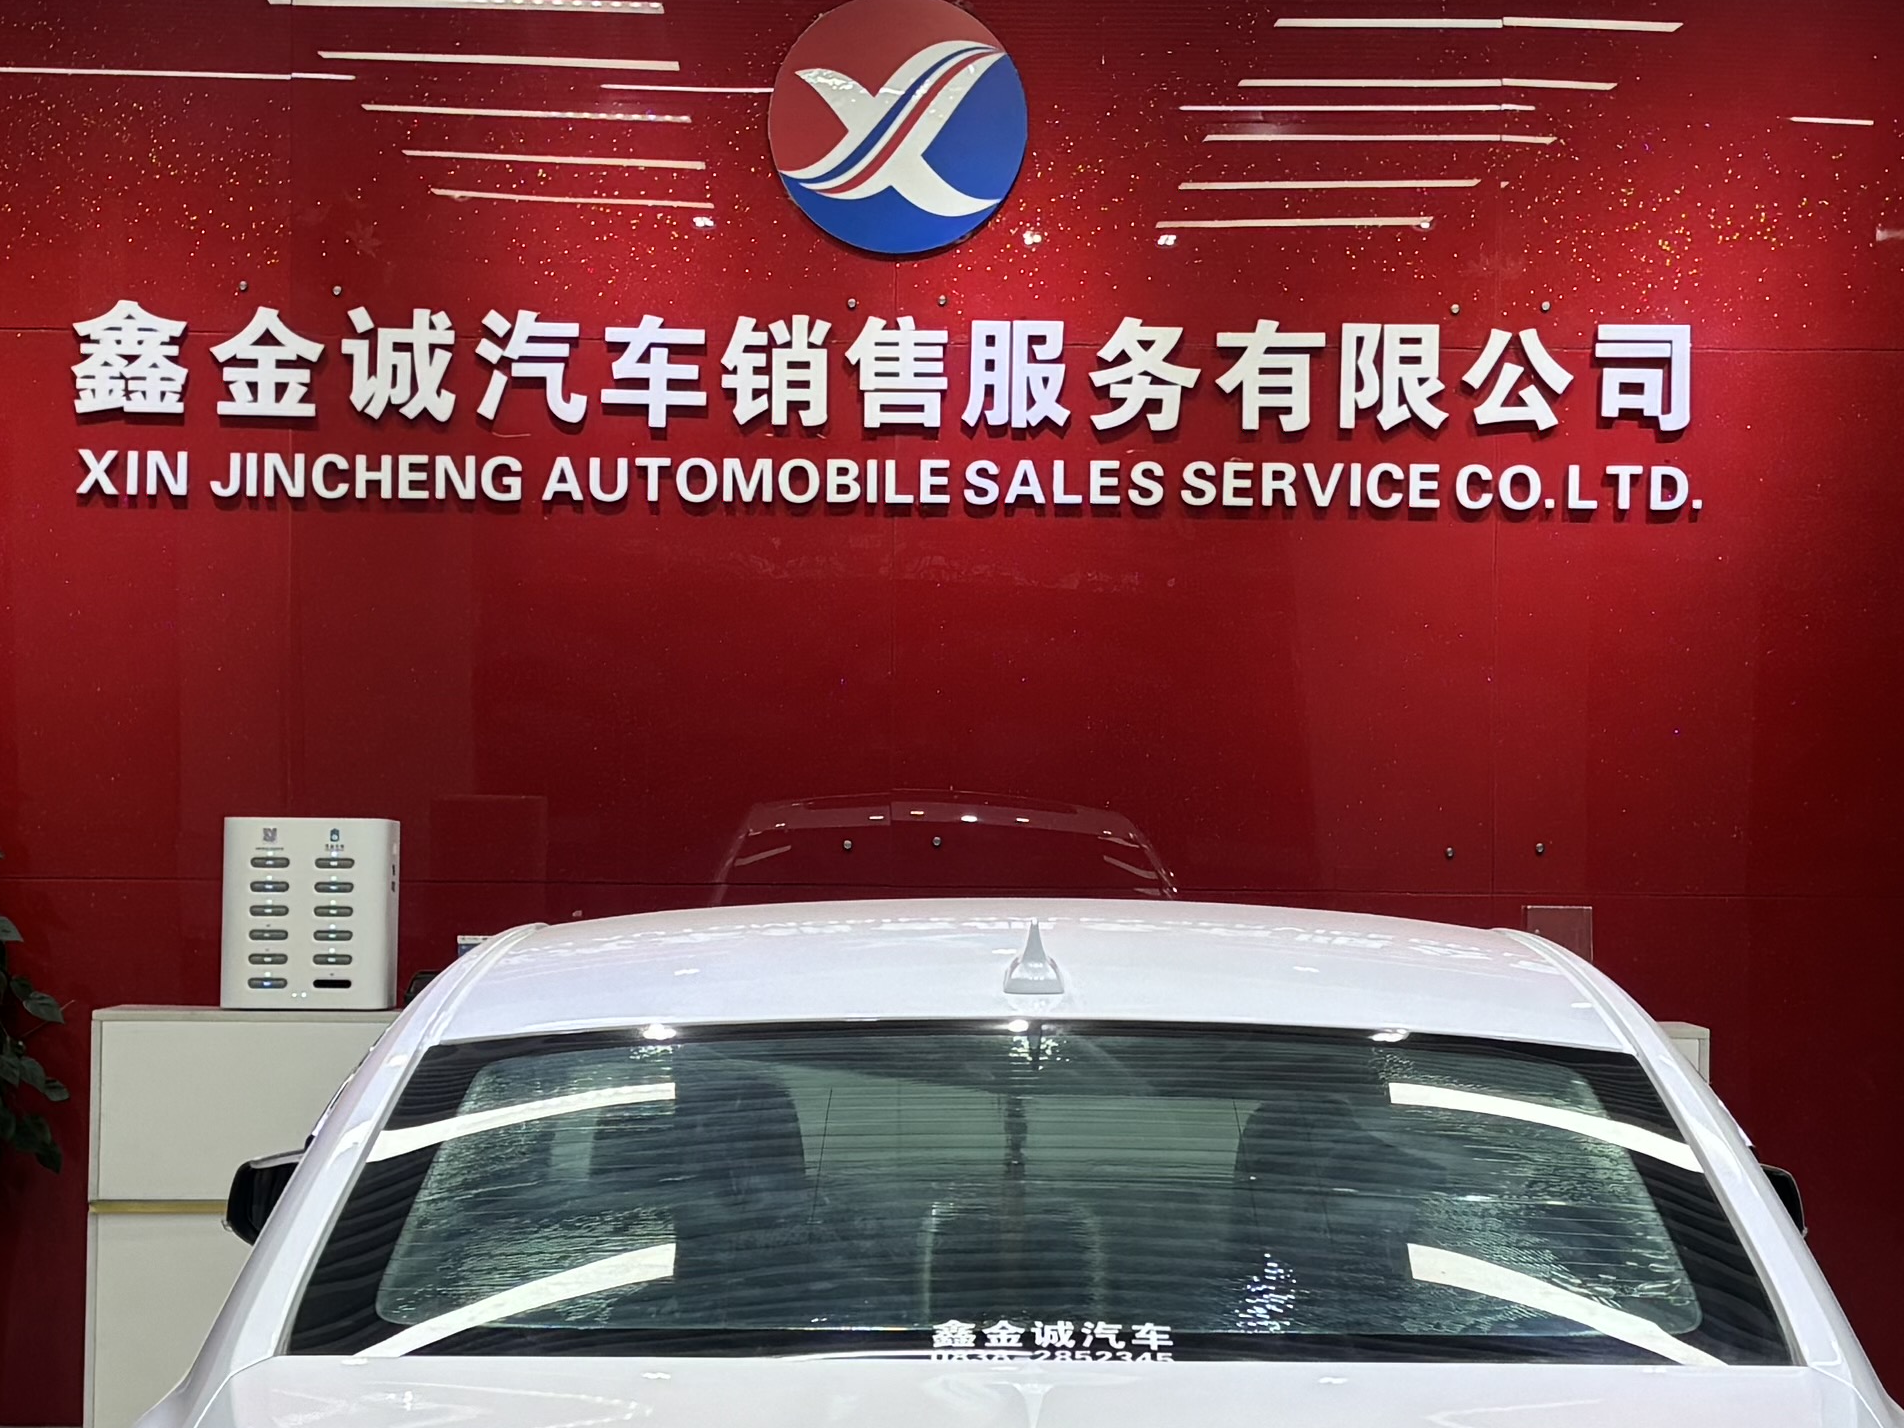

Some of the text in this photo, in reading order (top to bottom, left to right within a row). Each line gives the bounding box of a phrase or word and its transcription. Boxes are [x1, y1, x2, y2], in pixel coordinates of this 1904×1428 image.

[72, 299, 1693, 434] 鑫金诚汽车销售服务有限公司
[75, 448, 188, 497] XIN
[209, 451, 523, 501] JINCHENG
[542, 456, 951, 504] AUTOMOBILE
[963, 458, 1164, 507] SALES
[1180, 461, 1441, 509] SERVICE
[932, 1319, 1174, 1350] 鑫金诚汽车
